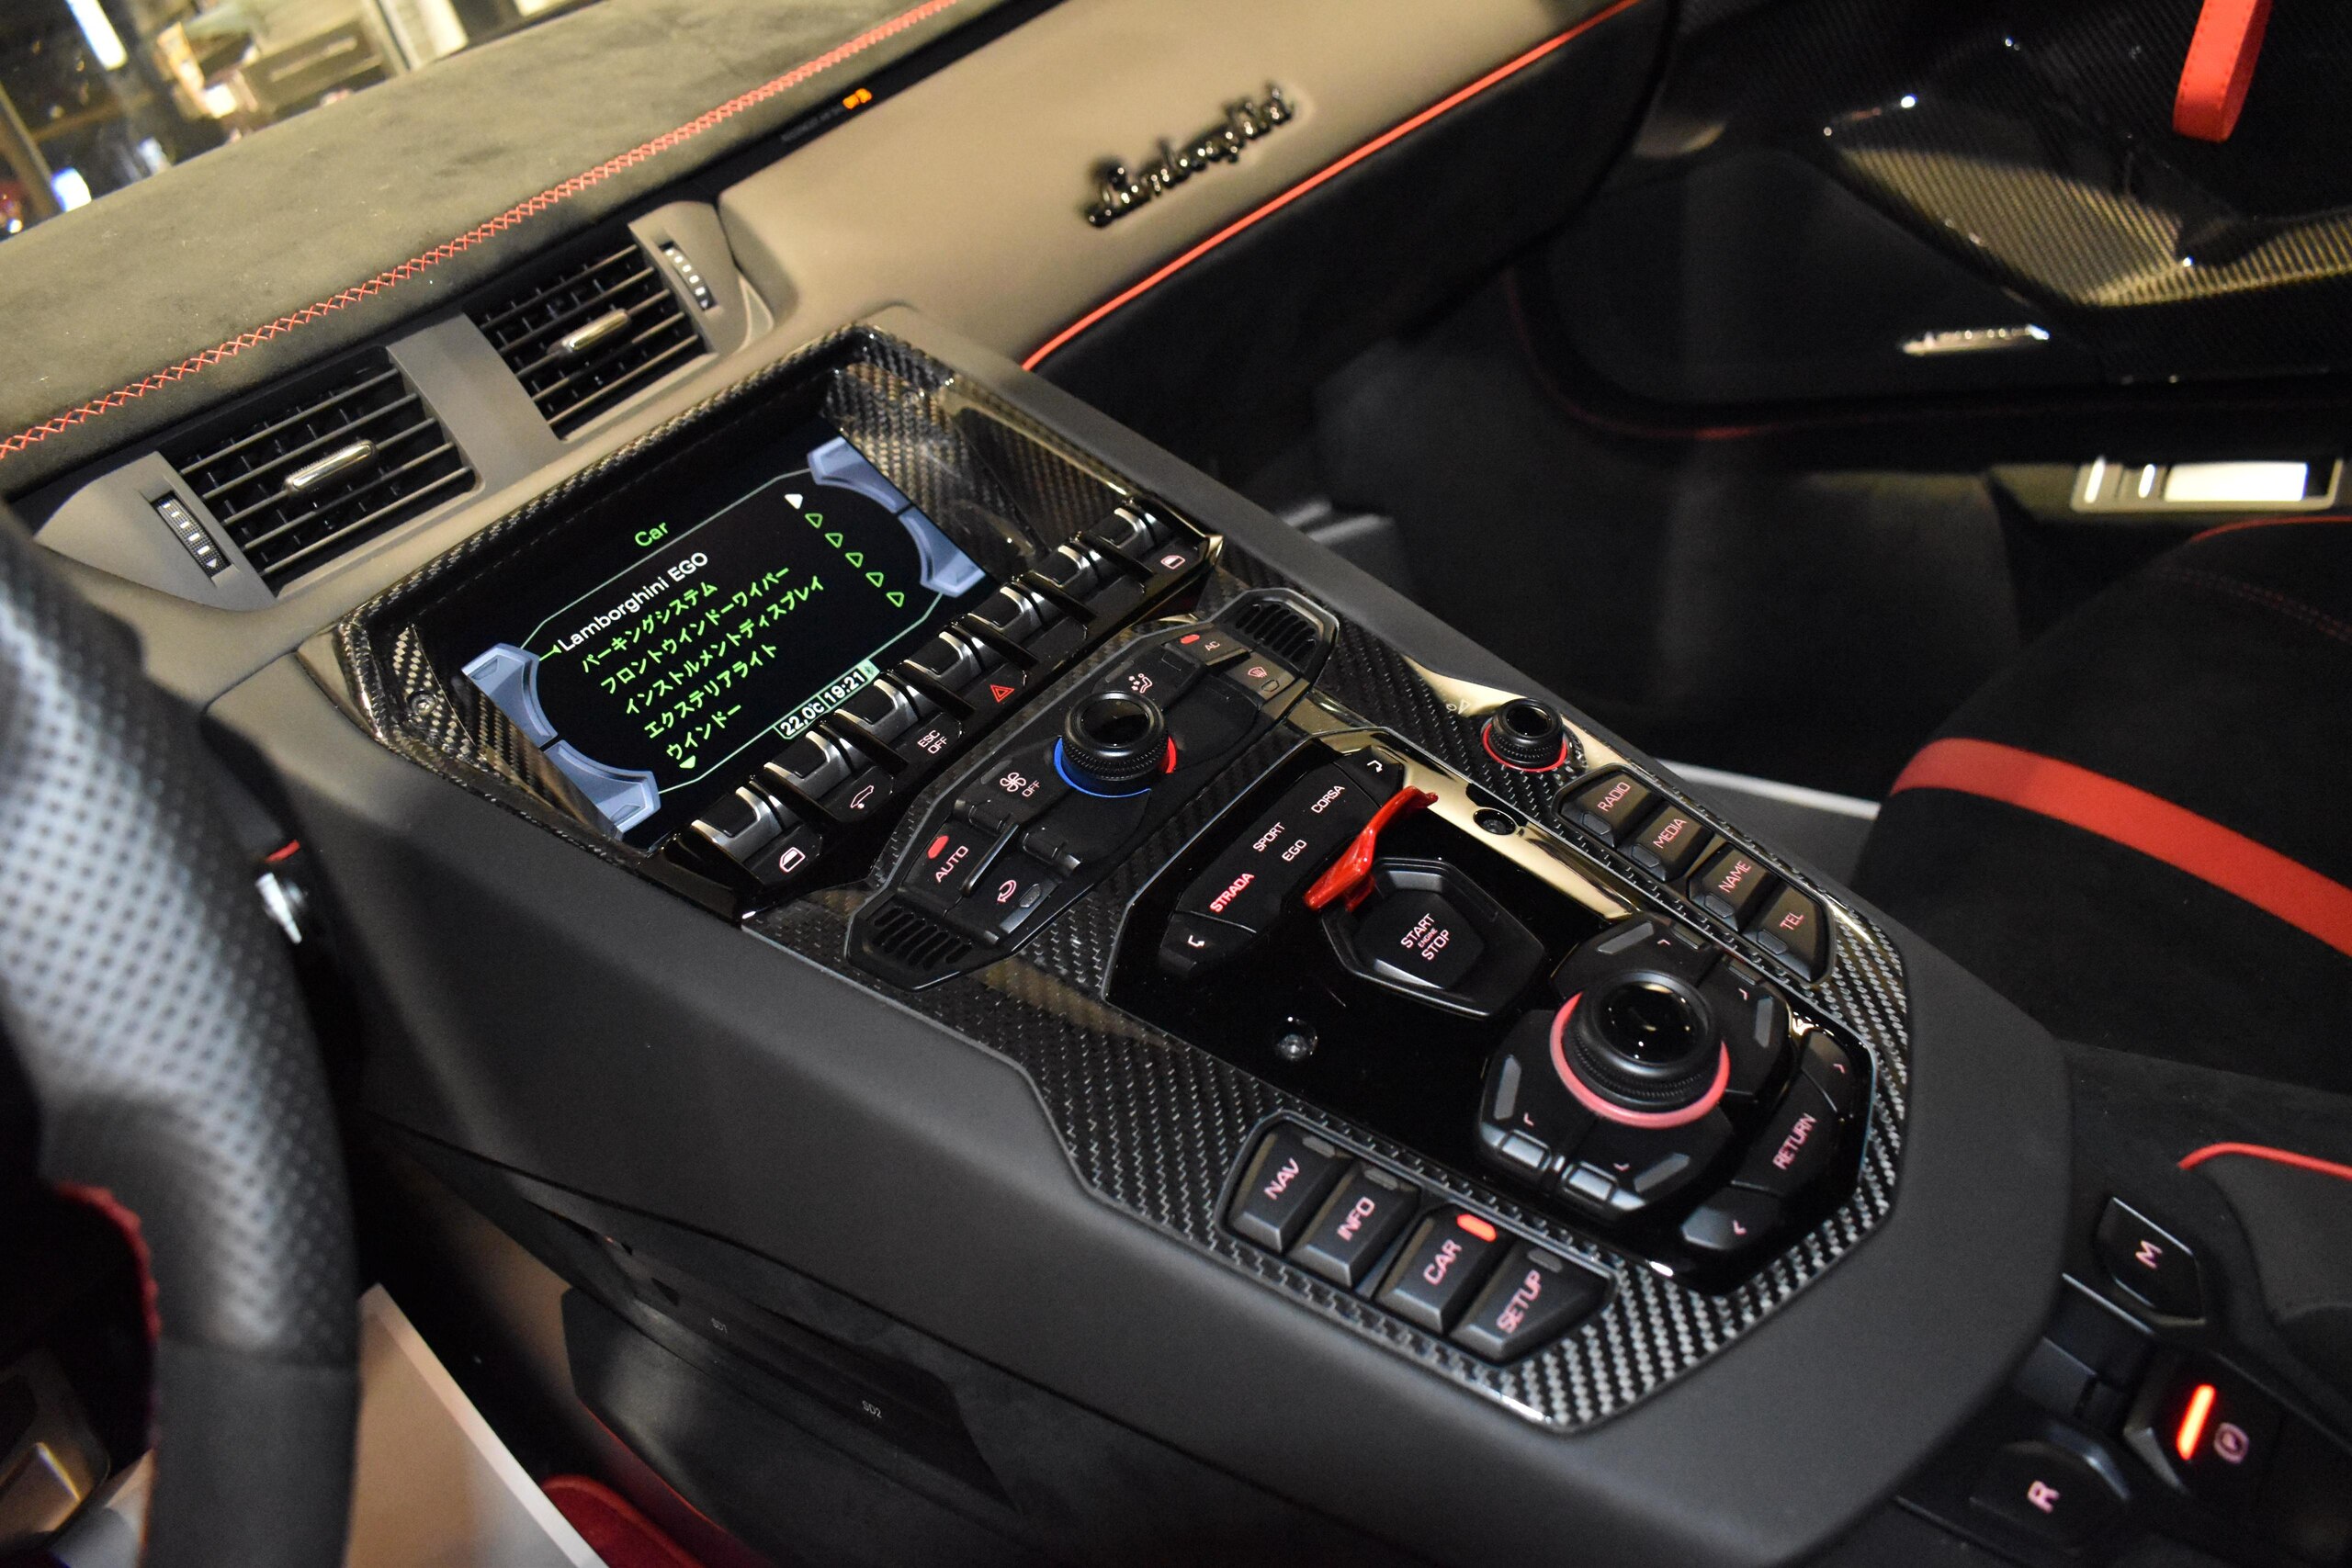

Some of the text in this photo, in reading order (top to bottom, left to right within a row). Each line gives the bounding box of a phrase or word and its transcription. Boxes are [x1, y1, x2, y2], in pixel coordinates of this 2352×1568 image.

[634, 522, 669, 547] Car
[557, 552, 708, 651] Lamborghini EGO
[582, 581, 718, 673] パーキングシステム
[1204, 640, 1221, 651] AC
[644, 644, 777, 739] エクステリアライト
[823, 671, 865, 704] 19:21
[917, 729, 941, 748] ESC
[927, 736, 948, 754] OFF
[1021, 780, 1041, 797] OFF
[1310, 784, 1346, 815] CORSA
[1597, 781, 1632, 813] RADIO
[1252, 821, 1286, 853] SPORT
[1653, 818, 1688, 850] MEDIA
[934, 845, 969, 884] AUTO
[1281, 839, 1308, 862] EGO
[1209, 873, 1256, 913] STRADA
[1718, 860, 1752, 894] NAME
[1400, 912, 1435, 949] START
[1780, 911, 1804, 931] TEL
[1417, 927, 1439, 948] ENGINE
[1421, 929, 1451, 961] STOP
[1772, 1112, 1817, 1170] RETURN
[1263, 1156, 1300, 1201] NAV
[1336, 1196, 1376, 1242] INFO
[1423, 1238, 1463, 1286] CAR
[2134, 1239, 2163, 1269] M
[1496, 1269, 1544, 1335] SETUP
[862, 1400, 883, 1419] SD2
[2027, 1480, 2061, 1514] R
